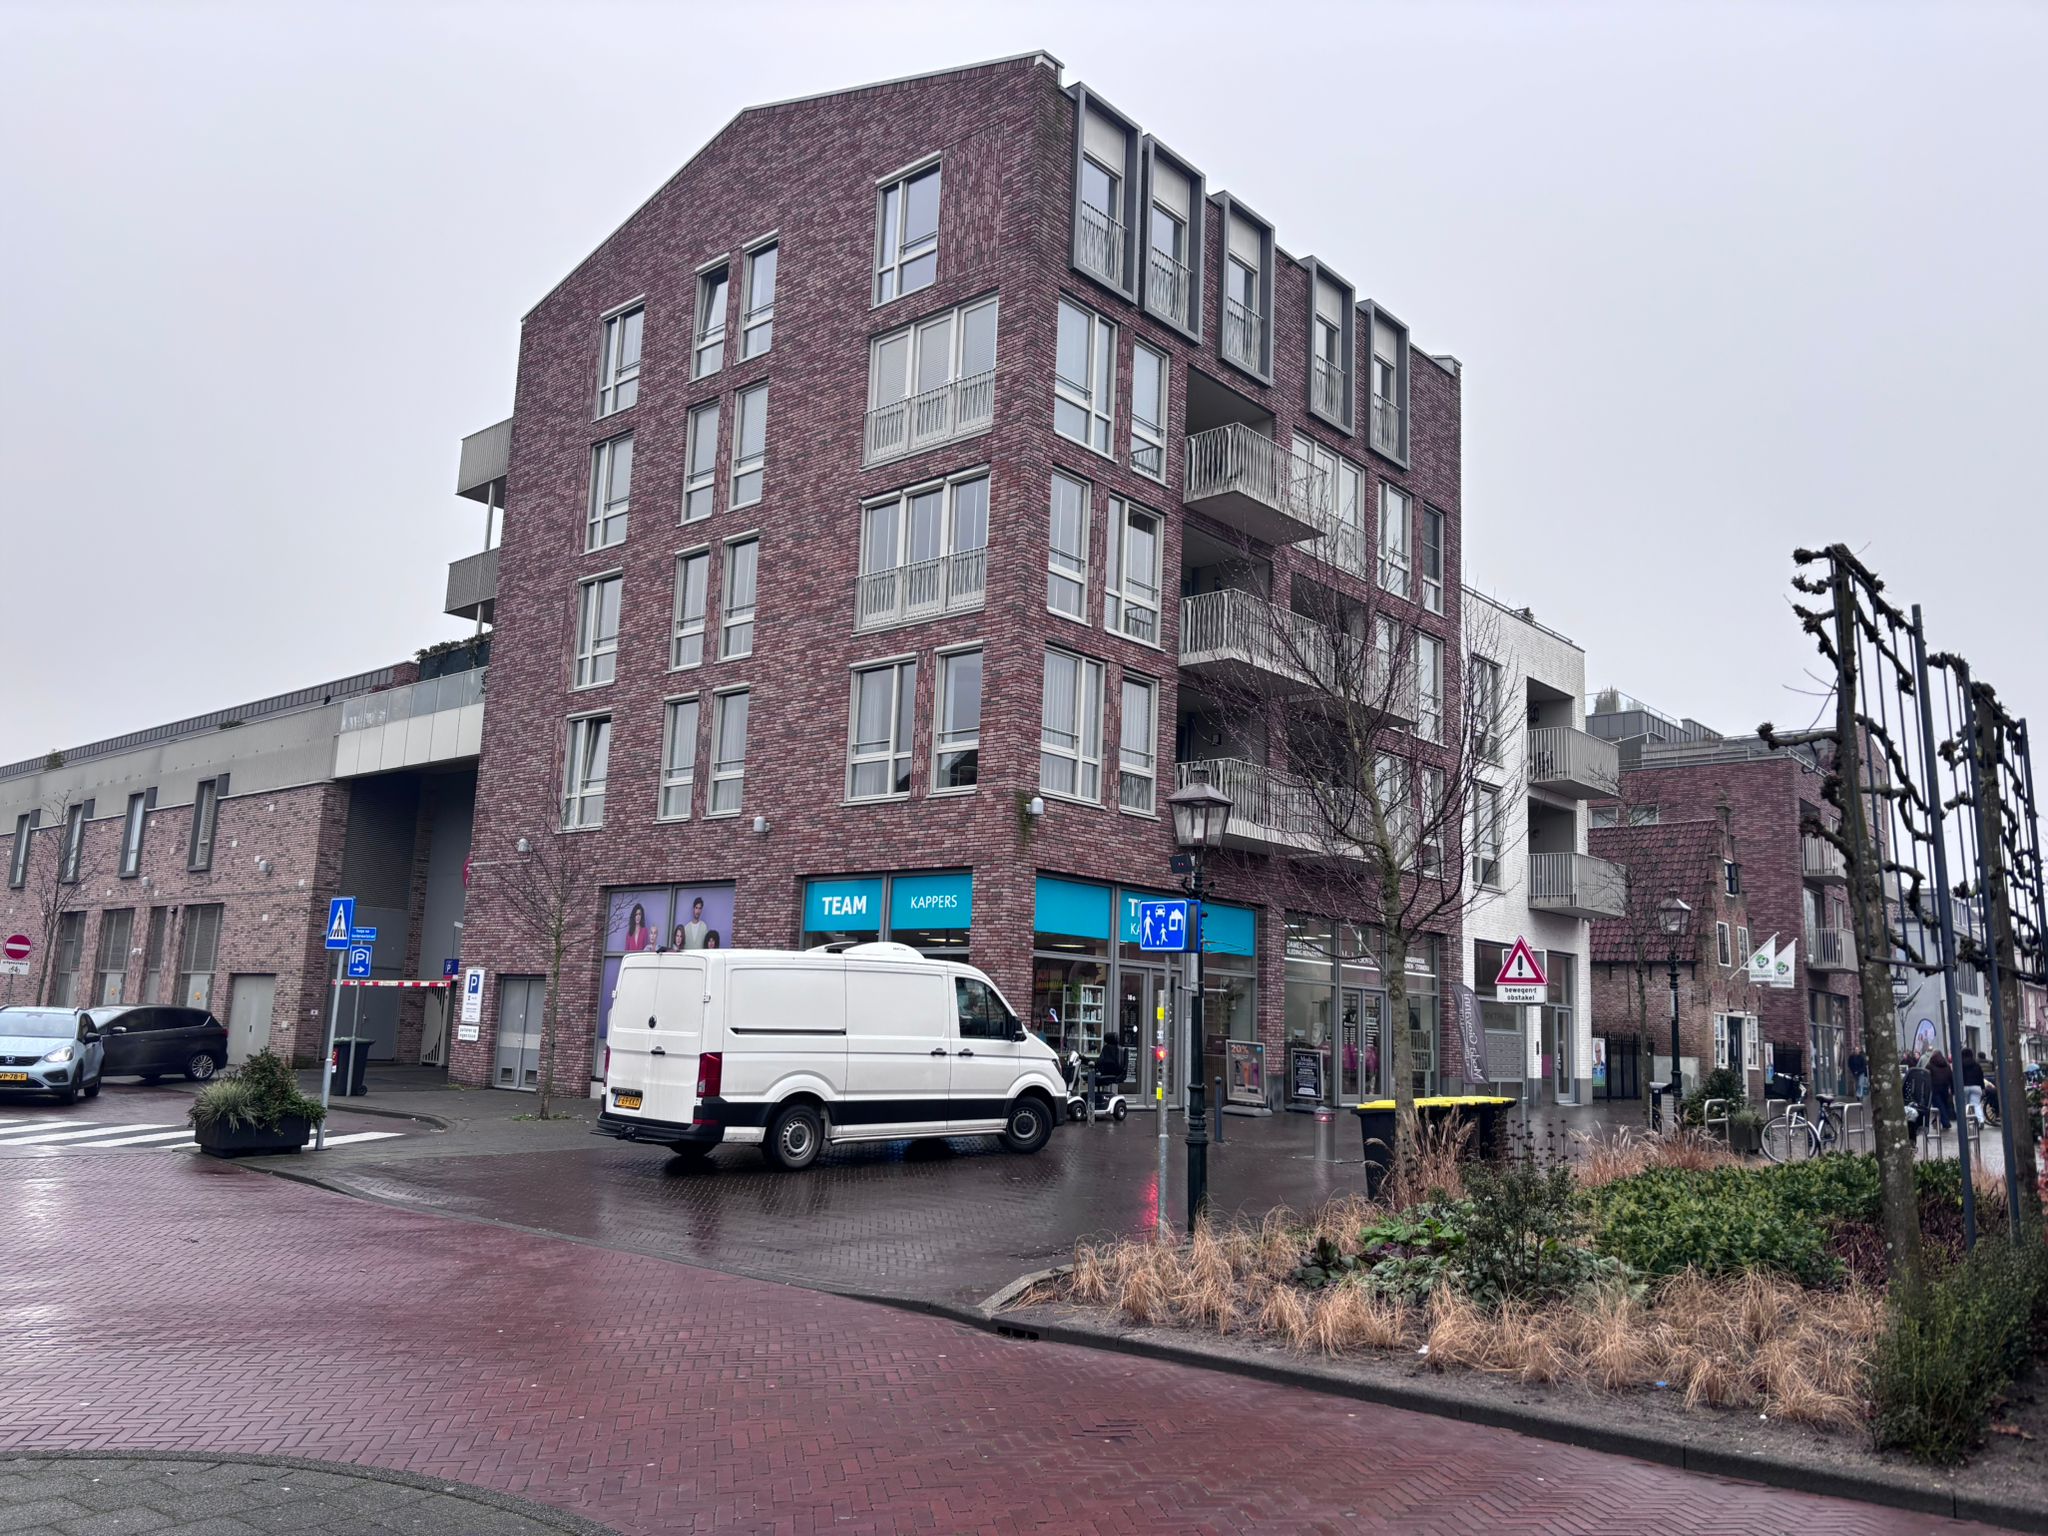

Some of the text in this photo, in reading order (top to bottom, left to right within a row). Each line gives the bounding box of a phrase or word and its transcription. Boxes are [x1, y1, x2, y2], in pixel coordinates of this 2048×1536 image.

[822, 895, 958, 916] TEAM KAPPERS
[470, 976, 478, 991] P
[1505, 987, 1537, 995] bewegend
[1231, 1044, 1249, 1054] 20%
